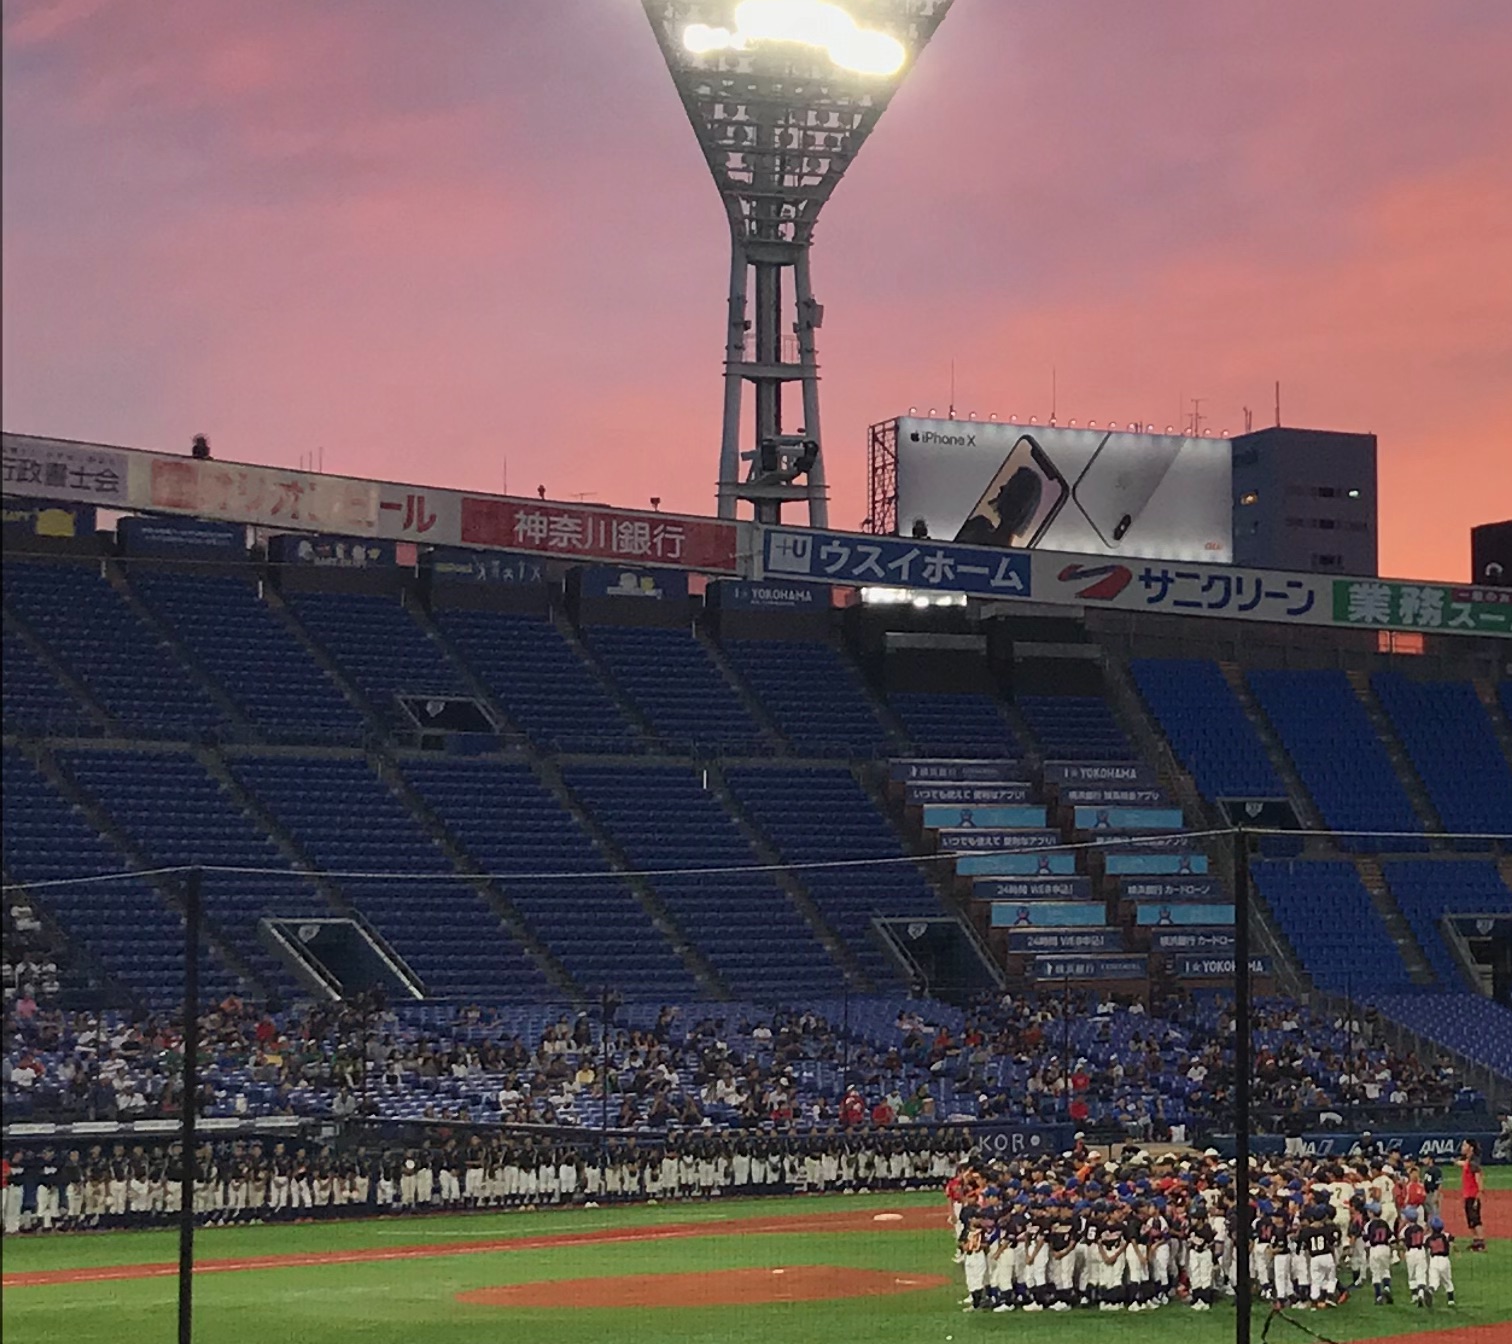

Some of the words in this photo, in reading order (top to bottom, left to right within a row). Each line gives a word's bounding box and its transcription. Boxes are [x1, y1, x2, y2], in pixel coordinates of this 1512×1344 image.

[921, 431, 965, 446] iPhone
[967, 435, 976, 447] X
[514, 509, 686, 559] 神奈川銀行
[819, 539, 1024, 593] ウスイホーム
[751, 588, 813, 603] YOKOHAMA
[1139, 567, 1315, 616] サニクリーン
[1079, 767, 1138, 779] YOKOHAMA
[1197, 935, 1236, 947] カードロー
[1419, 1138, 1455, 1155] ANA
